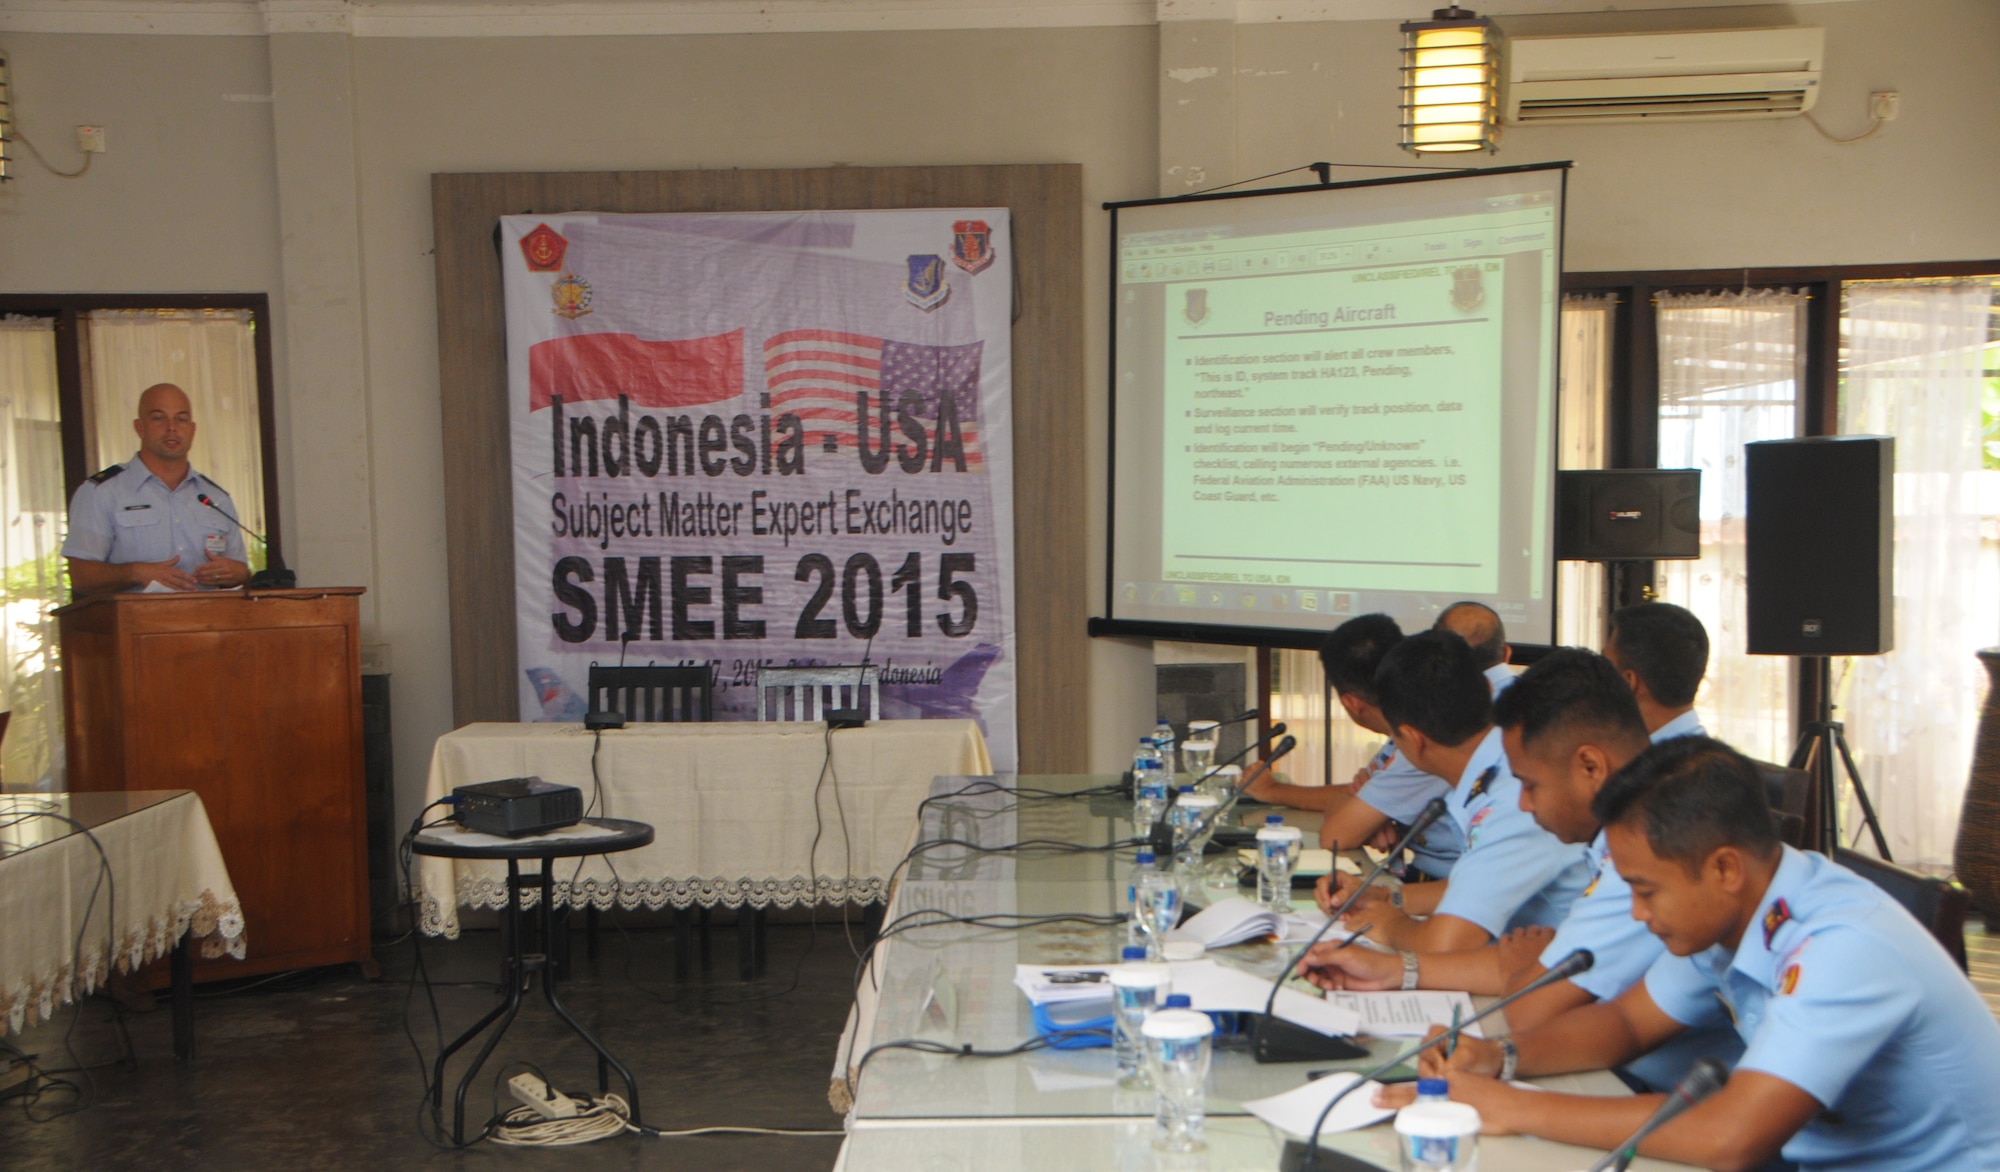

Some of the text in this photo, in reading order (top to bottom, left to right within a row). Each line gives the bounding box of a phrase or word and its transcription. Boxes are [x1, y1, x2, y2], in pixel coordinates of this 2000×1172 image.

[1424, 241, 1447, 251] Tools
[1463, 237, 1483, 249] Sign
[1497, 232, 1546, 246] Comment
[1264, 303, 1396, 328] Pending Aircraft
[1195, 355, 1260, 366] Identification
[1263, 353, 1301, 363] section
[1303, 350, 1322, 361] will
[1324, 350, 1349, 360] alert
[1351, 348, 1364, 359] all
[1367, 349, 1394, 358] crew
[1223, 371, 1232, 381] is
[1251, 371, 1289, 383] system
[1291, 368, 1317, 379] track
[1320, 366, 1359, 378] HA123,
[1194, 401, 1463, 418] Surveillance section will verify track position, data
[551, 393, 804, 478] Indonesia
[857, 389, 968, 475] USA
[1194, 423, 1298, 436] and log current time.
[1194, 442, 1258, 453] Identification
[1261, 442, 1279, 452] will
[1280, 441, 1311, 455] begin
[1243, 458, 1277, 472] calling
[1280, 460, 1333, 469] numerous
[1336, 457, 1380, 468] external
[1382, 456, 1437, 471] agencies.
[1194, 475, 1231, 486] Federal
[1232, 474, 1275, 486] Aviation
[1277, 474, 1355, 486] Administration
[1358, 474, 1390, 488] (FAA)
[1393, 475, 1410, 486] US
[1448, 474, 1467, 485] US
[1193, 491, 1222, 501] Coast
[1261, 492, 1280, 502] etc.
[551, 487, 972, 550] Subject Matter Expert Exchange
[551, 551, 978, 644] SMEE 2015
